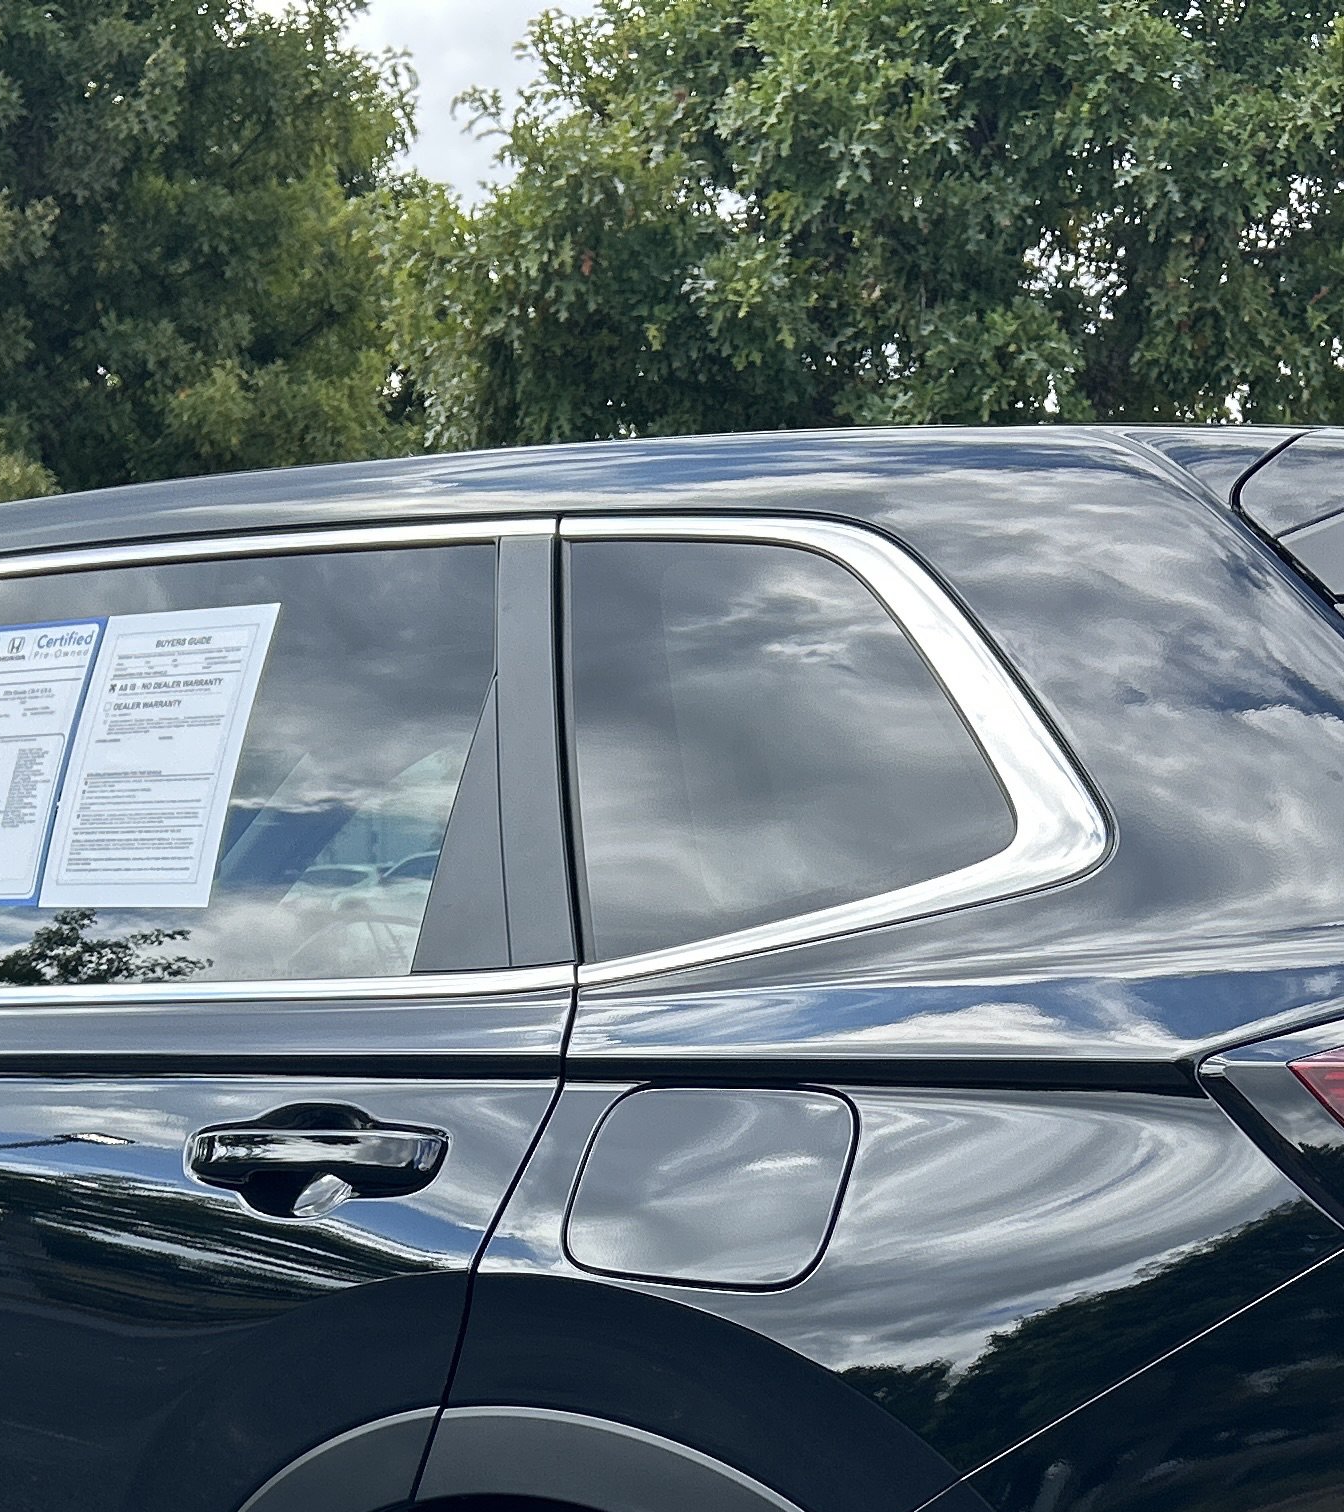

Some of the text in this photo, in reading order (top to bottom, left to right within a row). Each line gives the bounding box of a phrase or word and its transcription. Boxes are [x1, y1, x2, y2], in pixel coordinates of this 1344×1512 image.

[37, 630, 95, 649] Certified
[155, 636, 212, 648] BUYERS GUIDE
[141, 682, 152, 690] NO
[152, 679, 182, 690] DEALER
[182, 678, 223, 687] WARRANTY
[113, 700, 182, 711] DEALER WARRANTY
